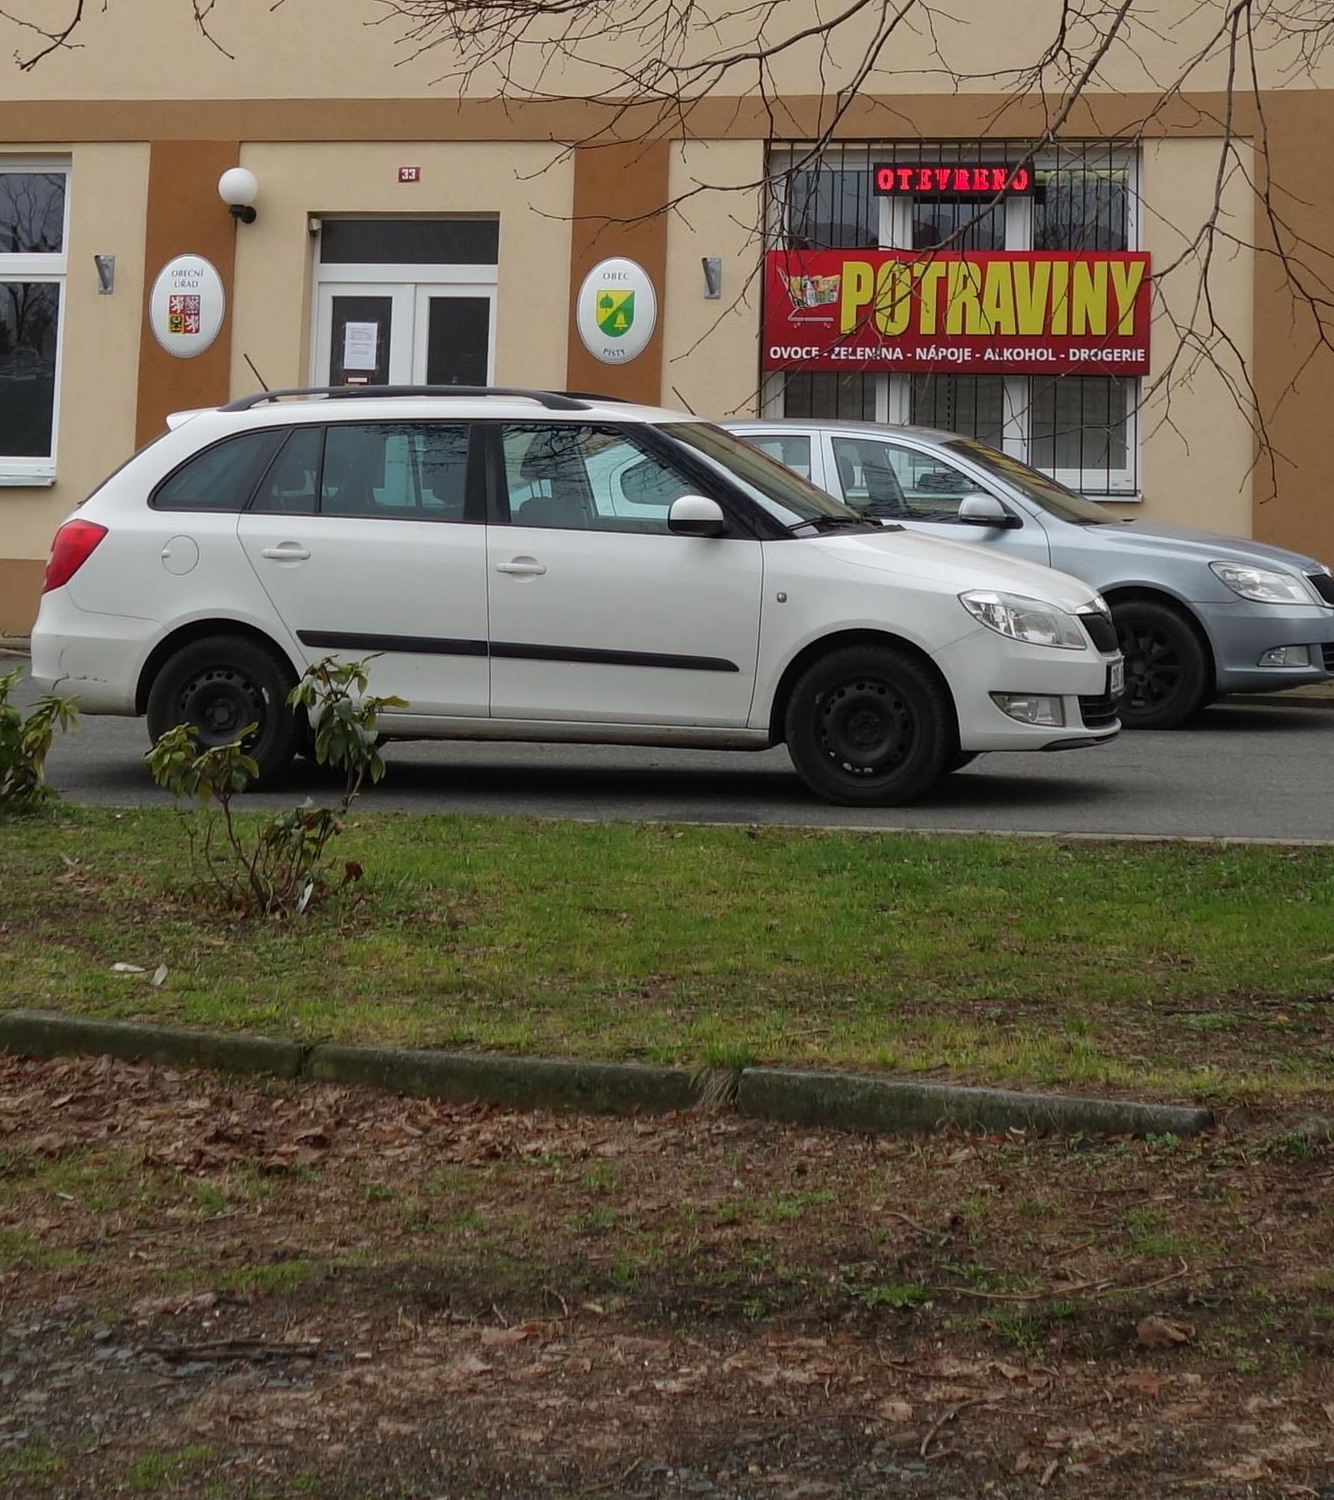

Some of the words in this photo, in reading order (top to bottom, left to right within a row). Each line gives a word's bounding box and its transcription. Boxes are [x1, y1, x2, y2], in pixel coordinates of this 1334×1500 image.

[401, 168, 417, 180] 33
[172, 269, 204, 278] OBECNÍ
[602, 272, 630, 281] OBEC
[174, 280, 199, 288] ÚŘAD
[839, 261, 1146, 336] POTRAVINY
[603, 347, 626, 357] PÍSTY
[769, 346, 820, 360] OVOCE
[915, 344, 972, 363] NÁPOJE
[983, 347, 1057, 361] ALKOHOL
[1069, 348, 1145, 362] DROGERIE
